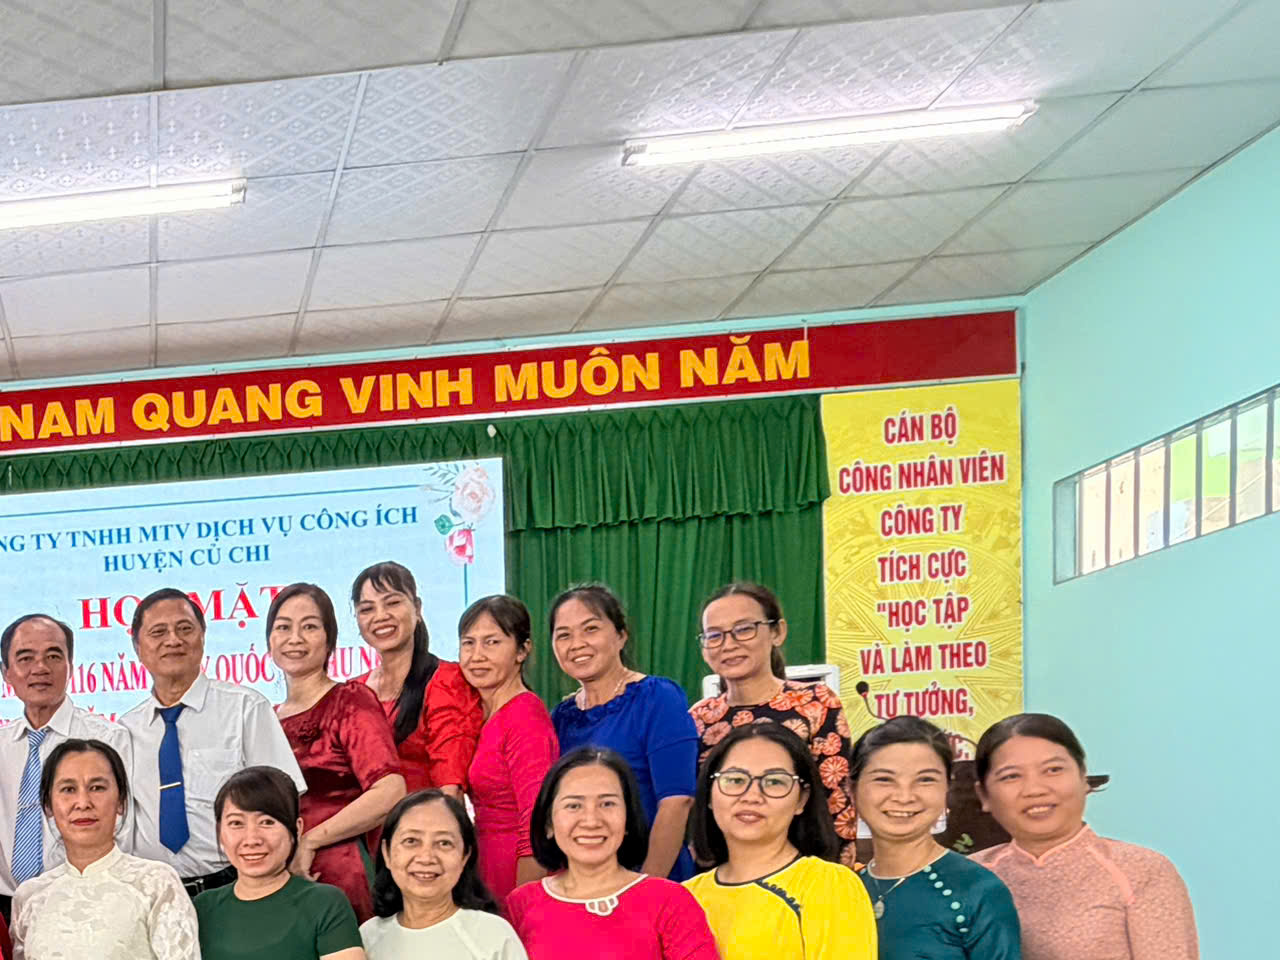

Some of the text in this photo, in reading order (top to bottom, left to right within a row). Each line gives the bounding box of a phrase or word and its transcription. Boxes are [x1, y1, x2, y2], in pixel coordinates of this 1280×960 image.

[0, 397, 116, 442] NAM
[131, 379, 323, 432] QUANG
[340, 367, 474, 415] VINH
[494, 346, 661, 402] MUÔN
[679, 334, 811, 389] NĂM
[884, 406, 957, 445] CÁN BỘ
[839, 450, 1005, 494] CÔNG NHÂN VIÊN
[30, 533, 63, 550] TY
[66, 526, 132, 548] TNHH
[138, 523, 191, 543] MTV
[197, 517, 255, 543] DỊCH
[261, 515, 293, 538] VỤ
[300, 508, 369, 533] CÔNG
[375, 504, 418, 526] ÍCH
[880, 504, 963, 537] CÔNG TY
[104, 543, 270, 574] HUYỆN CỦ CHI
[878, 548, 967, 583] TÍCH CỰC
[77, 594, 144, 635] HỌ
[877, 592, 970, 632] "HỌC TẬP
[100, 652, 147, 692] NĂM
[215, 643, 275, 684] QUỐC
[860, 641, 987, 675] VÀ LÀM THEO
[875, 681, 974, 720] TƯ TƯỞNG,
